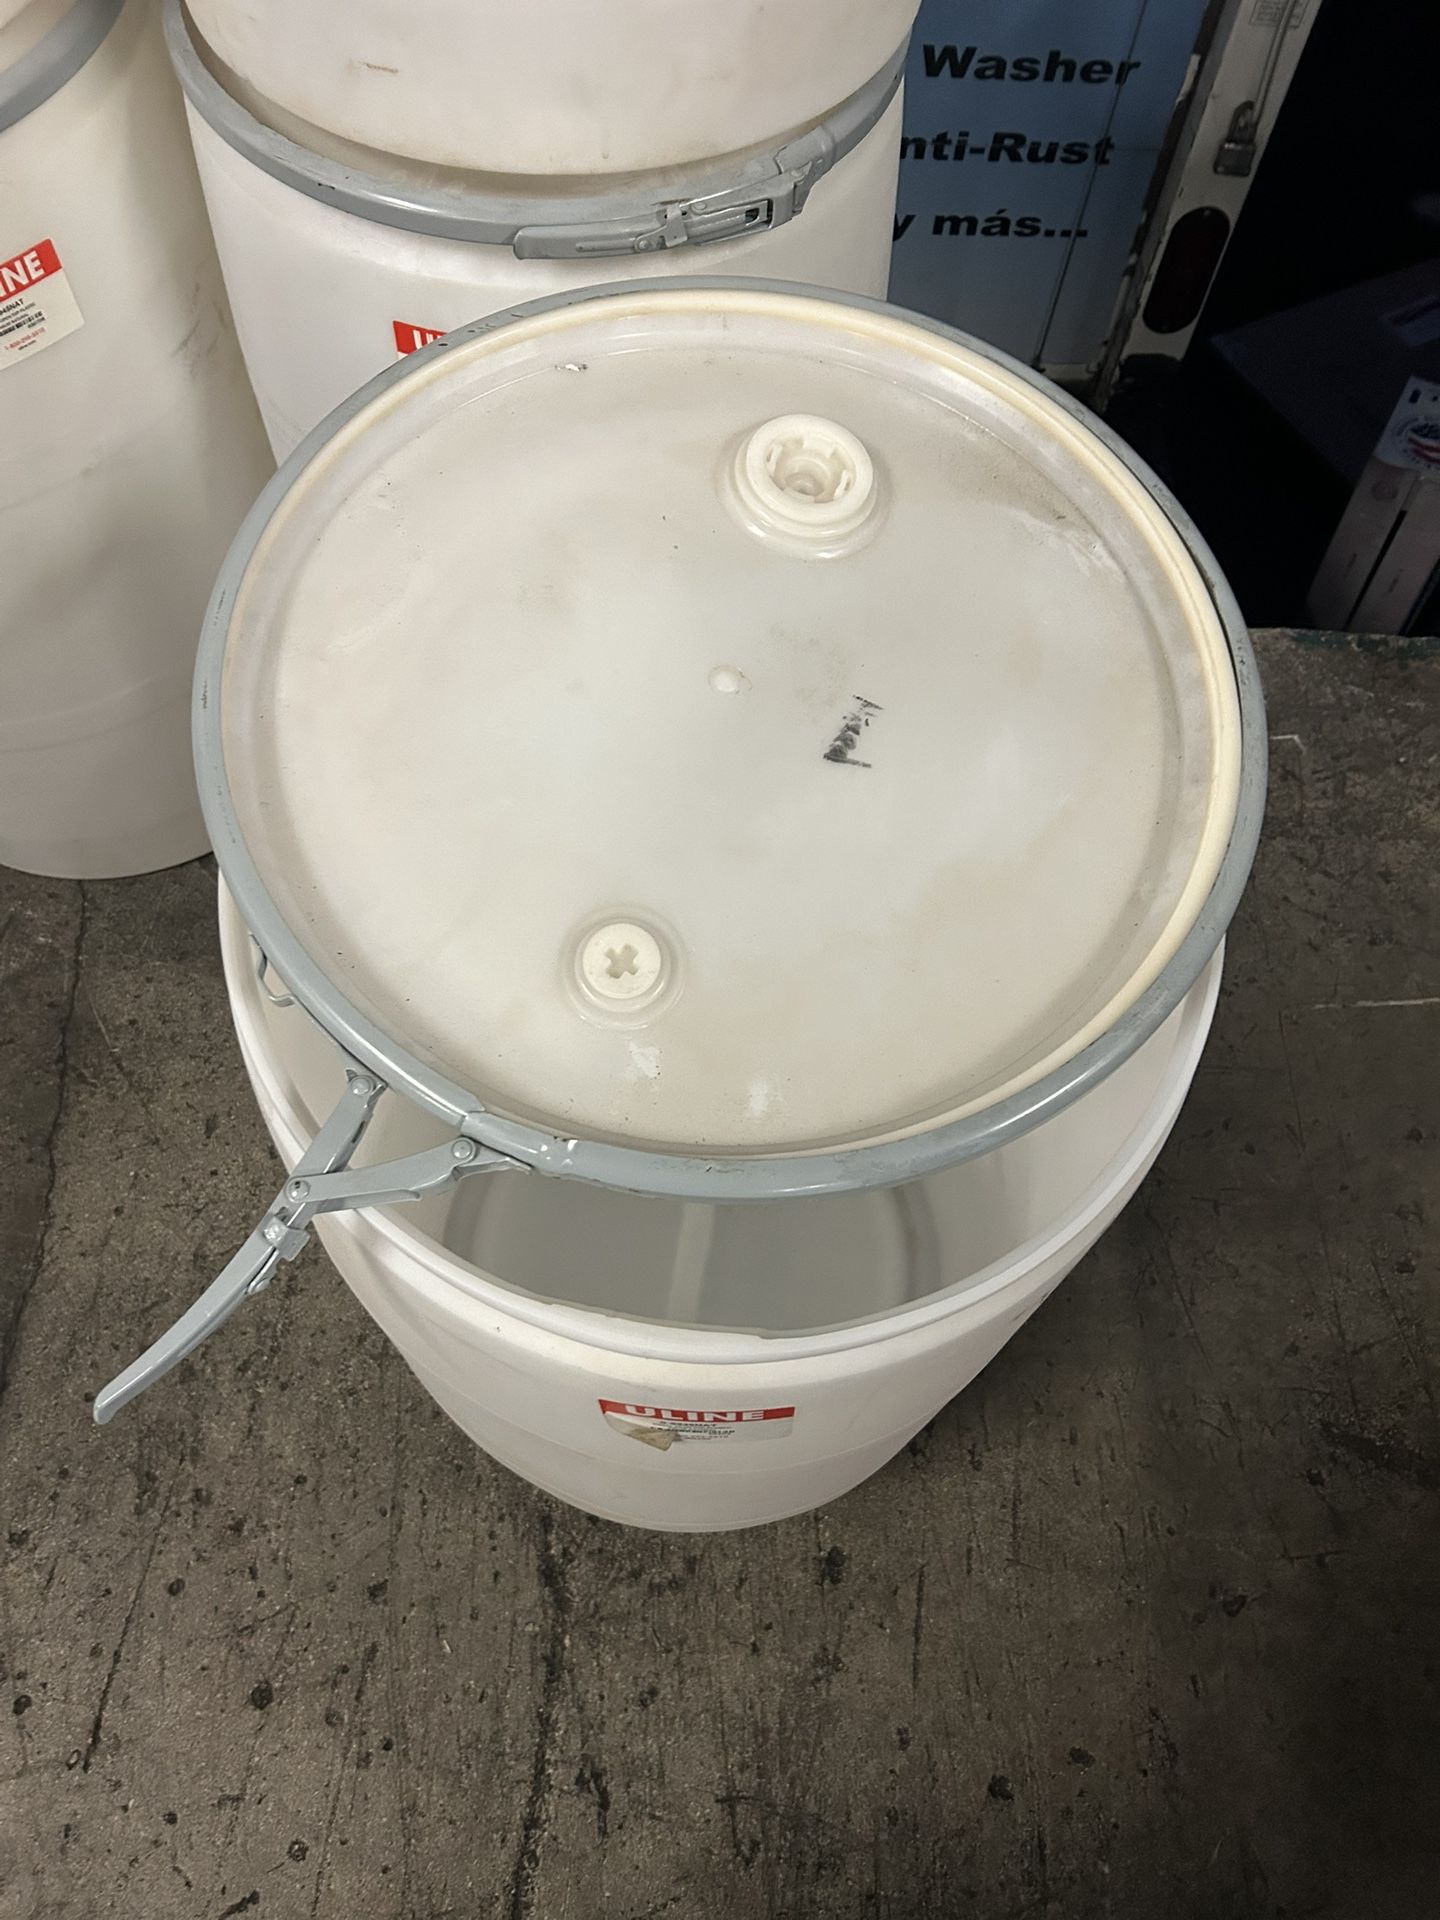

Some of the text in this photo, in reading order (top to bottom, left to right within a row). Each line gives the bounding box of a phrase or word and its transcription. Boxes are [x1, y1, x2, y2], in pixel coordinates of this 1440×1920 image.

[922, 44, 1141, 86] Washer
[900, 130, 1115, 166] nti-Rust
[932, 208, 1088, 238] más...
[624, 1404, 765, 1422] ULINE
